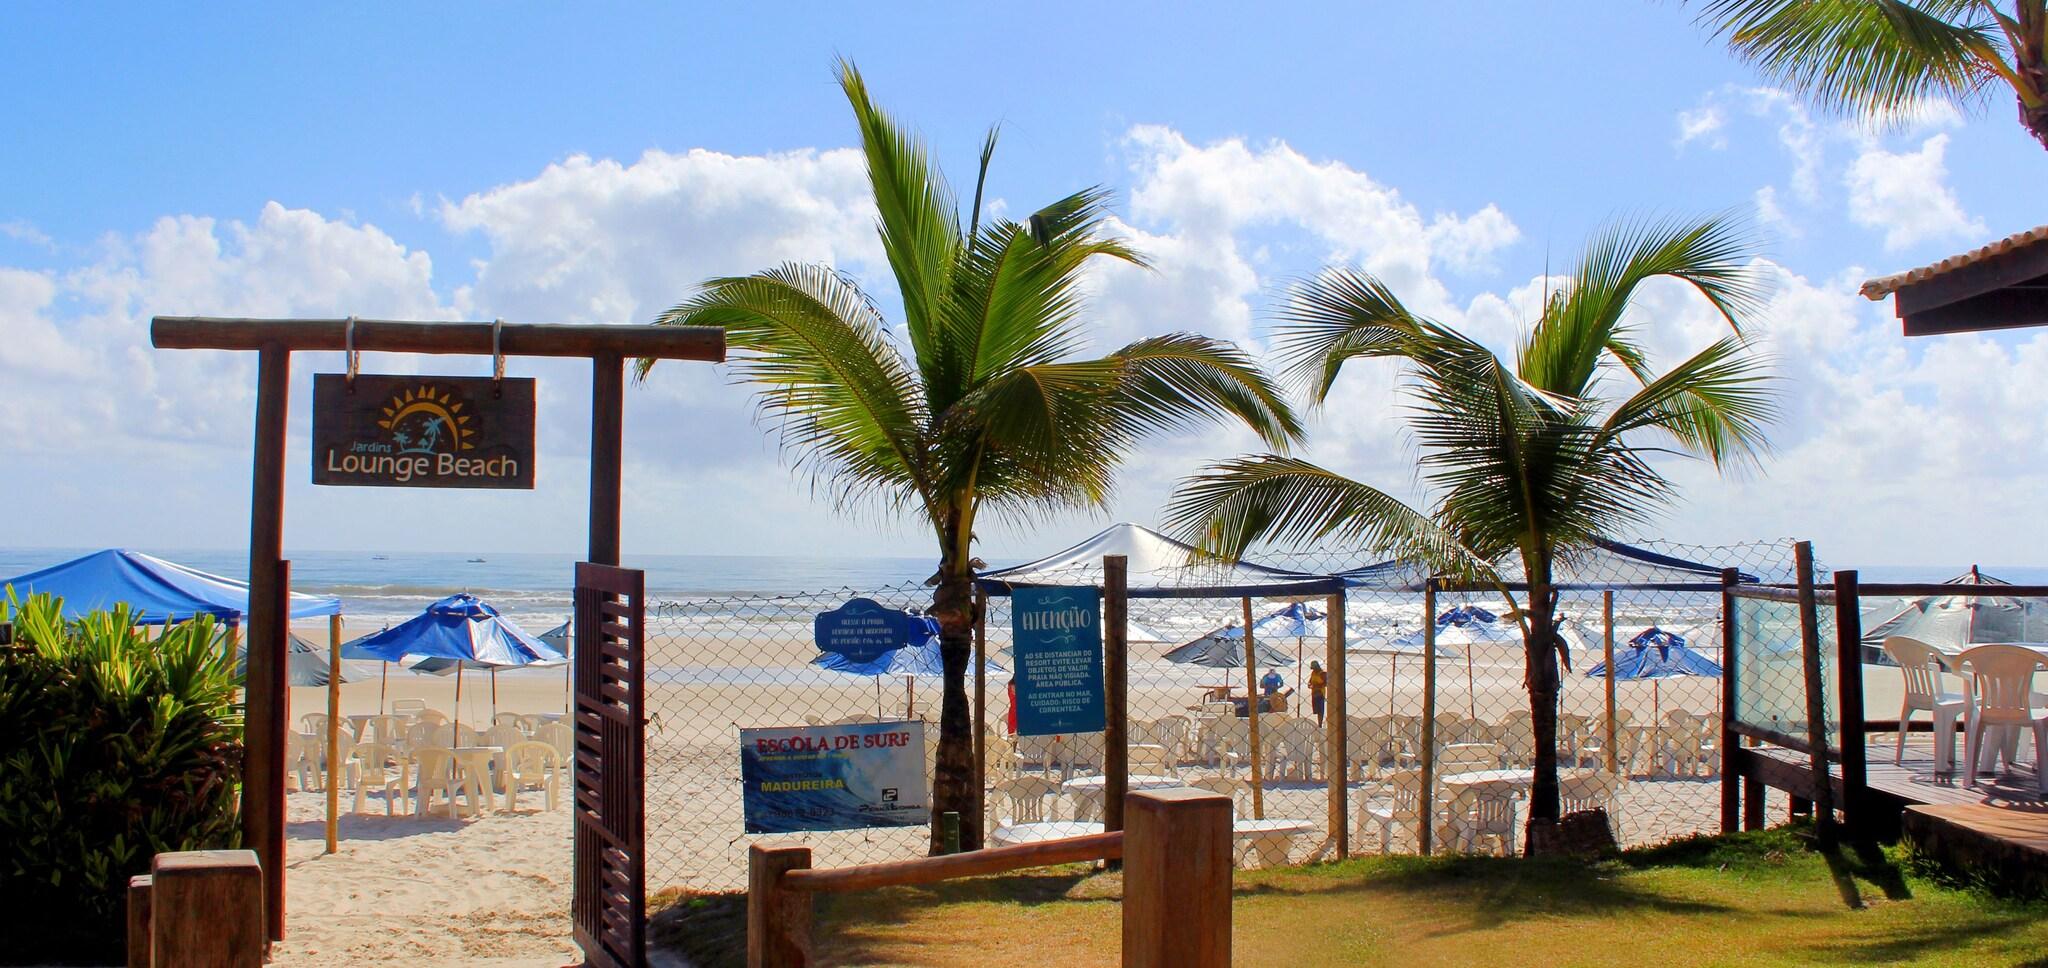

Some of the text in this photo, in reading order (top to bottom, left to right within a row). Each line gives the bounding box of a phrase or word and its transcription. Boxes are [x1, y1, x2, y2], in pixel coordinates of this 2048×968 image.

[350, 440, 392, 453] Jardins
[327, 449, 518, 482] Lounge Beach
[1022, 606, 1091, 633] ATENÇÃO
[1044, 650, 1082, 658] DISTANCIAR
[1083, 649, 1092, 657] DO
[1025, 659, 1051, 667] RESORT
[1027, 666, 1057, 674] OBJETOS
[1028, 673, 1048, 681] PRAIA
[1048, 671, 1062, 679] NÃO
[1038, 691, 1065, 699] ENTRAR
[757, 731, 910, 753] ESCOLA DE SURF
[760, 779, 844, 792] MADUREIRA
